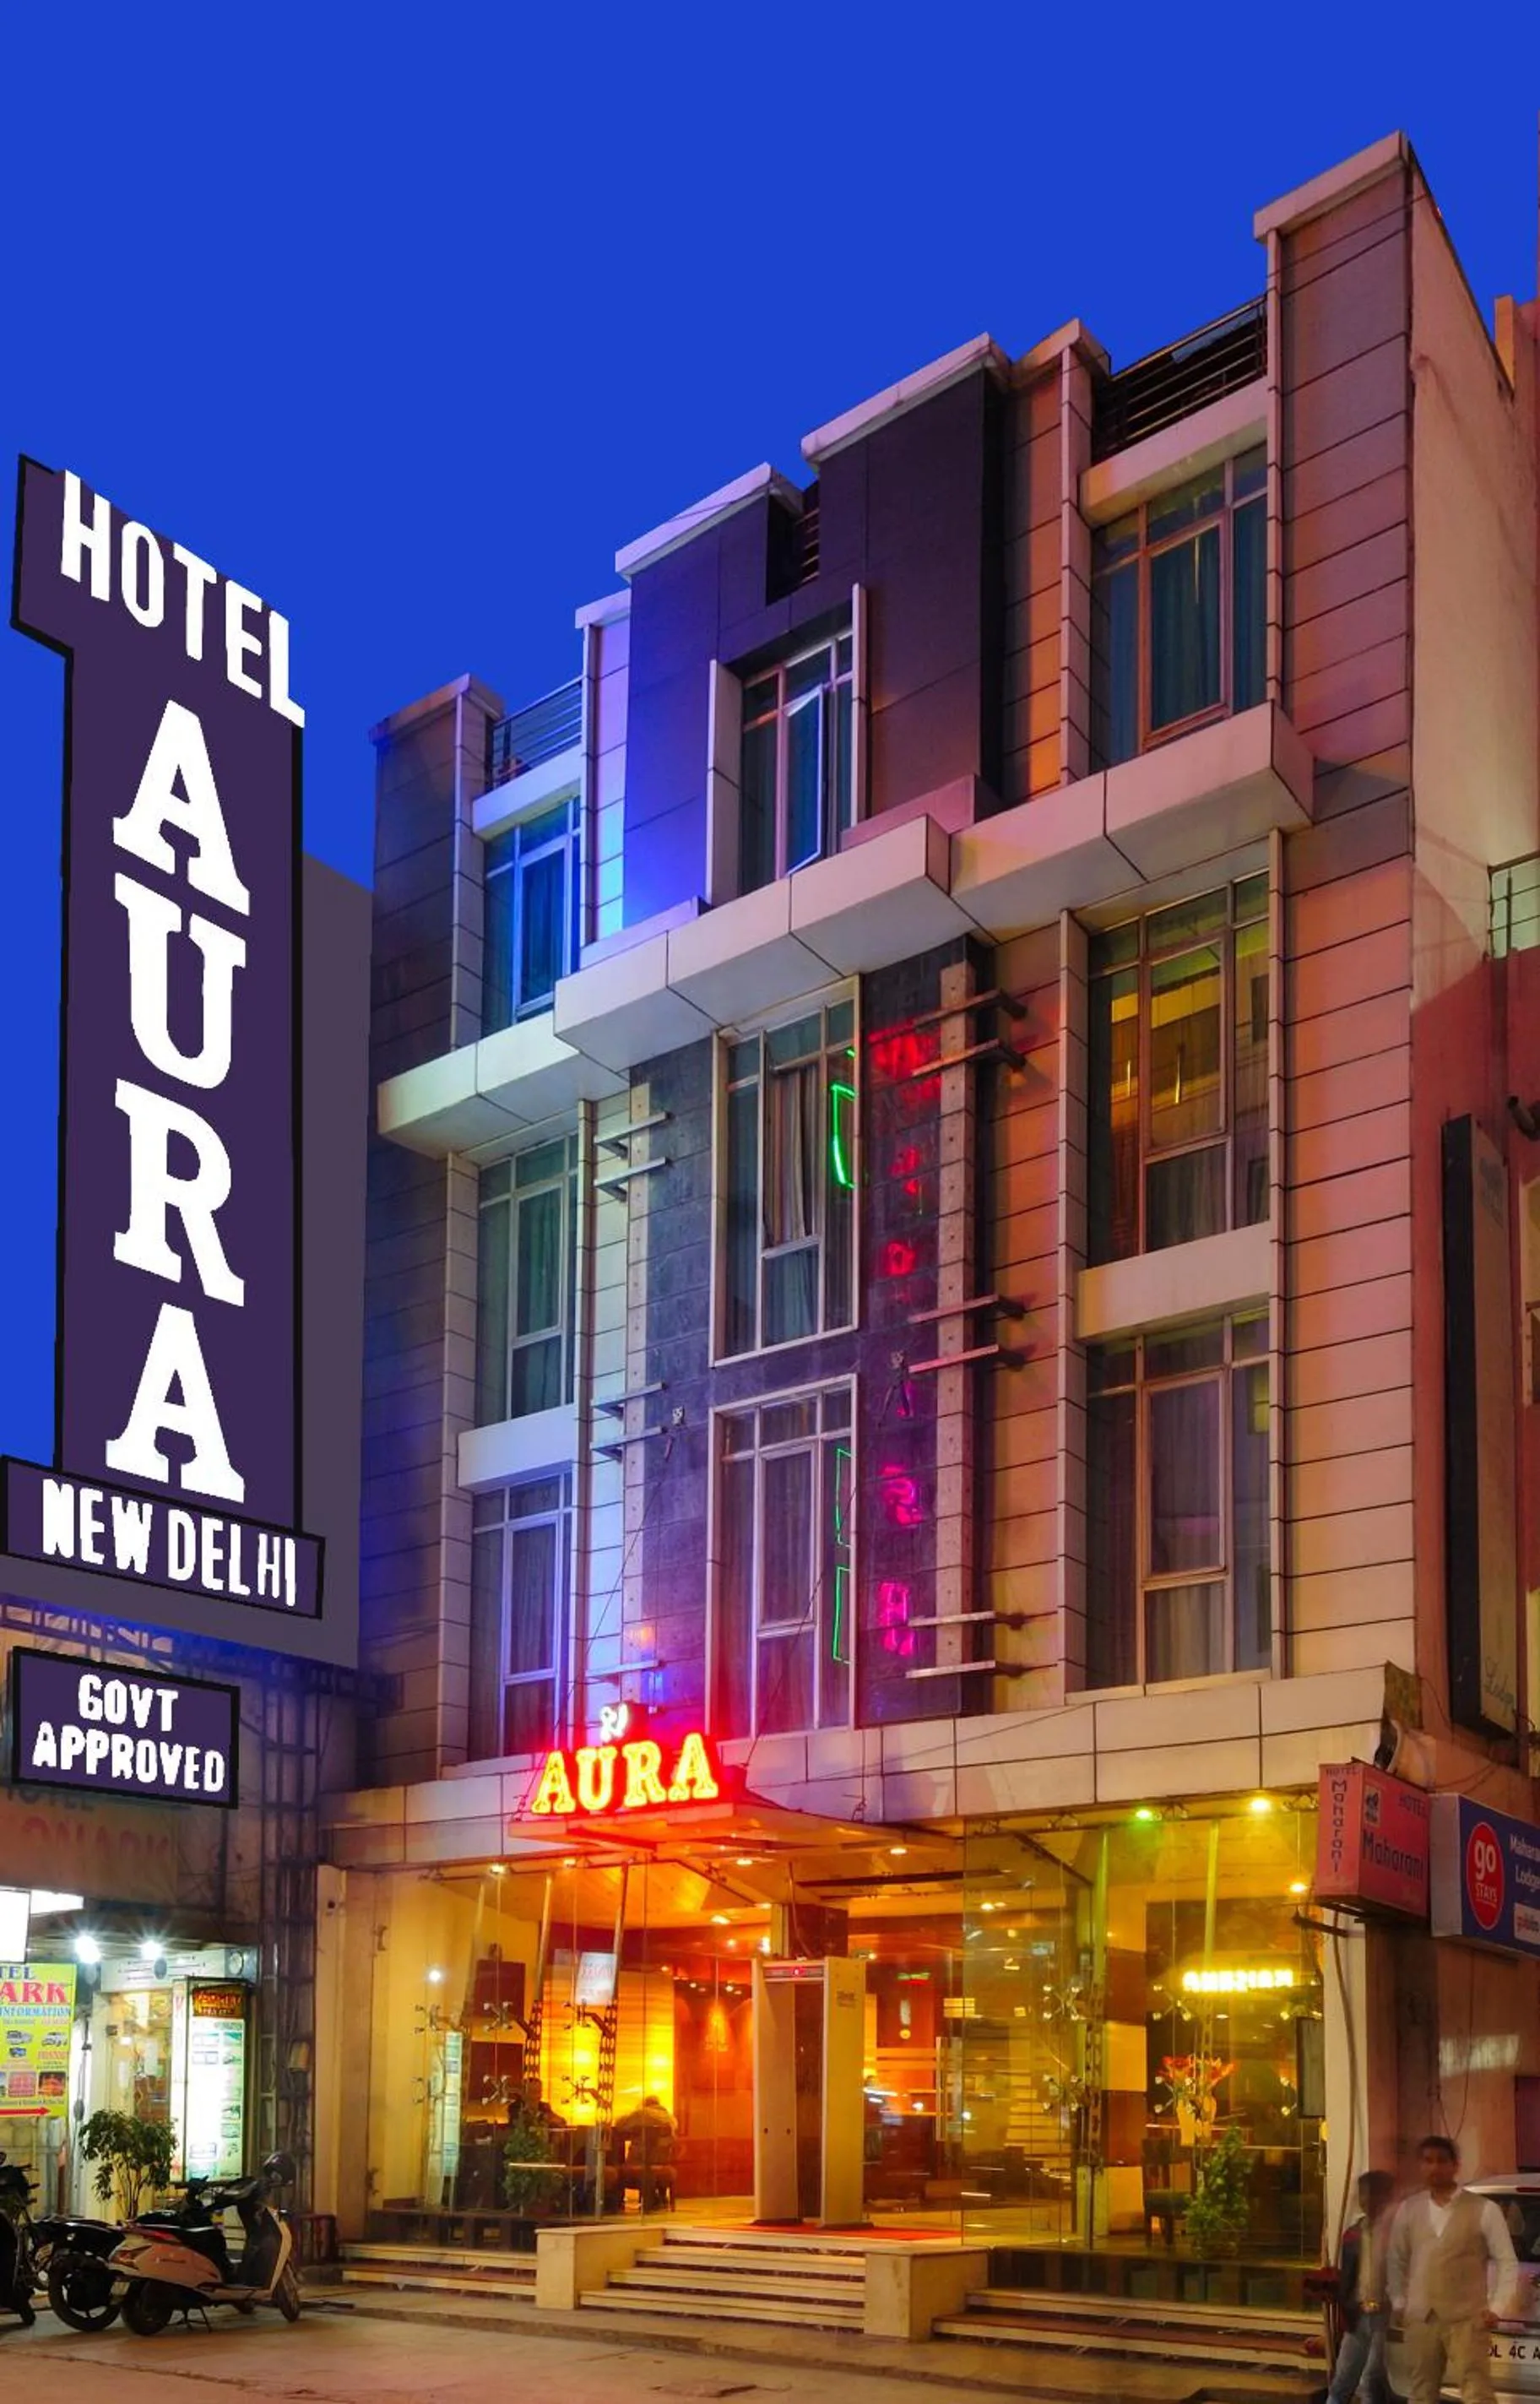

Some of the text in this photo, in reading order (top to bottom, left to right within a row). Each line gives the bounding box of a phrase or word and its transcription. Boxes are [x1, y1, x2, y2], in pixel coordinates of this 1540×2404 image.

[62, 469, 305, 729] HOTEL
[106, 700, 250, 1503] AURA
[42, 1479, 296, 1607] NEW DELHI
[78, 1674, 179, 1732] GOVT
[32, 1722, 225, 1793] APPROVED
[531, 1732, 718, 1814] AURA
[1363, 1828, 1423, 1881] Maharani
[1474, 1839, 1497, 1881] go
[1475, 1882, 1499, 1902] STAYS
[1509, 2345, 1526, 2359] 4C
